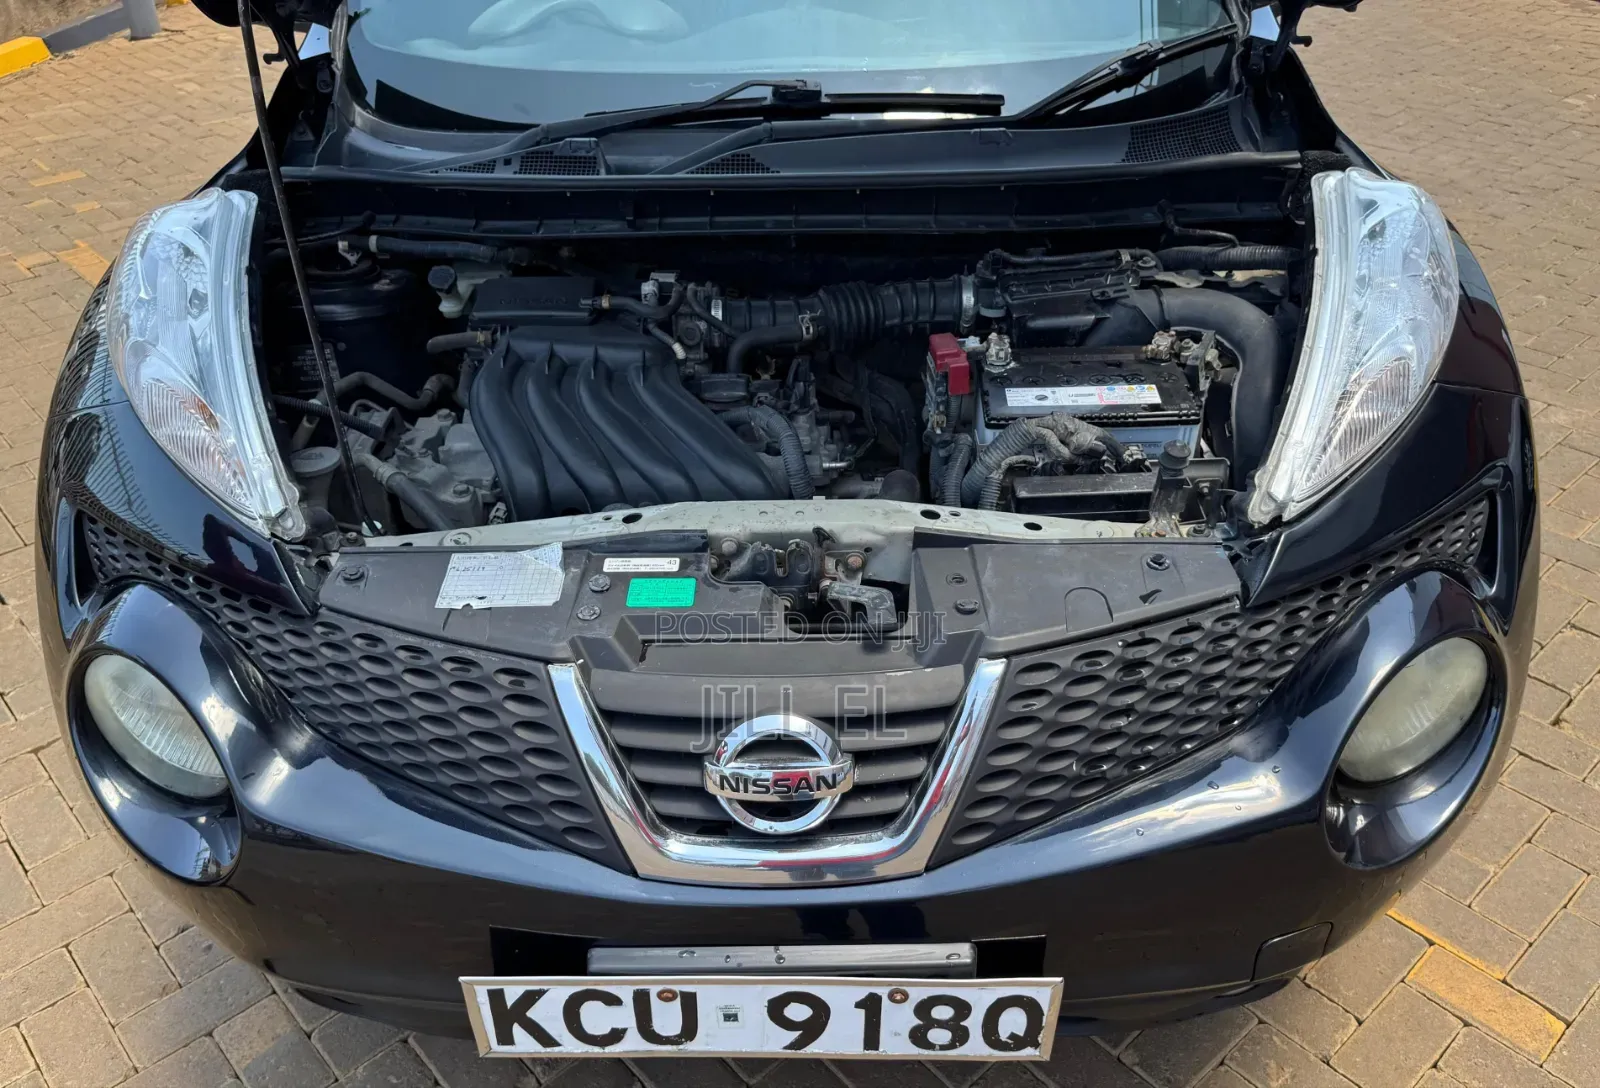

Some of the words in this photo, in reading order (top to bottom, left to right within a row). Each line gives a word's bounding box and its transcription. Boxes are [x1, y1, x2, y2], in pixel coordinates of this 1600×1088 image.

[719, 773, 837, 796] NISSAN
[487, 987, 698, 1049] KCU
[767, 990, 1045, 1052] 918Q
